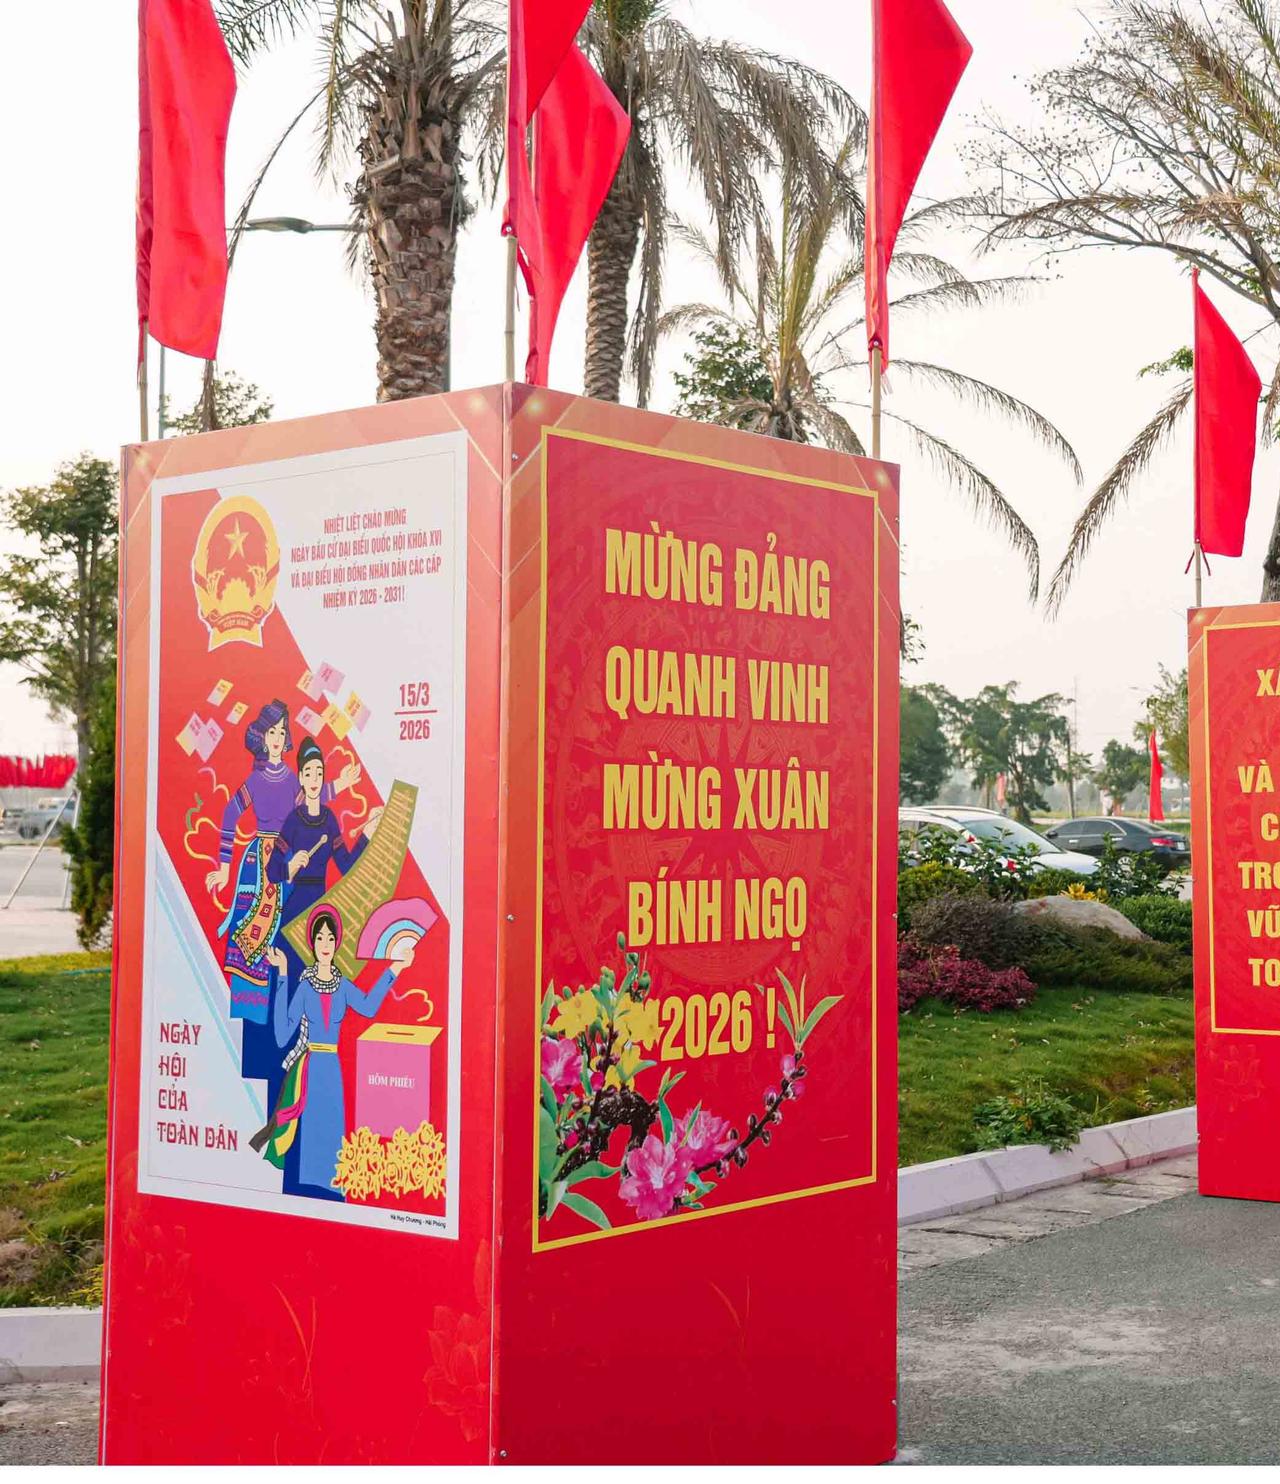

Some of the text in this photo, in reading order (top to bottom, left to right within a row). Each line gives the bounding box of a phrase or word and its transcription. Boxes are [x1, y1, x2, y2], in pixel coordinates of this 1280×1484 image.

[324, 506, 407, 536] NHIỆT LIỆT CHÀO MỪNG
[291, 544, 309, 563] NGÀY
[311, 539, 326, 561] BẦU
[353, 533, 369, 556] BIỂU
[371, 531, 391, 554] QUỐC
[393, 531, 405, 552] HỘI
[407, 528, 427, 549] KHÓA
[429, 530, 442, 546] XVI
[291, 568, 300, 588] VÀ
[302, 569, 313, 590] ĐẠI
[315, 563, 331, 586] BIỂU
[333, 566, 345, 587] HỘI
[369, 559, 389, 580] NHÂN
[391, 557, 407, 578] DÂN
[408, 555, 426, 576] CÁC
[427, 551, 441, 574] CẤP
[605, 521, 830, 620] MỪNG ĐẢNG
[323, 588, 346, 611] NHIỆM
[360, 589, 377, 605] 2026
[399, 682, 430, 707] 15/3
[605, 645, 829, 724] QUANH VINH
[400, 718, 431, 741] 2026
[603, 751, 829, 830] MỪNG XUÂN
[1238, 759, 1274, 793] VÀ
[628, 867, 807, 951] BÍNH NGỌ
[160, 1022, 201, 1046] NGÀY
[661, 987, 776, 1062] 2026 !
[159, 1052, 186, 1081] HỘI
[390, 1074, 415, 1088] PHIẾU
[159, 1082, 188, 1111] CỦA
[157, 1121, 237, 1151] TOÀN DÂN
